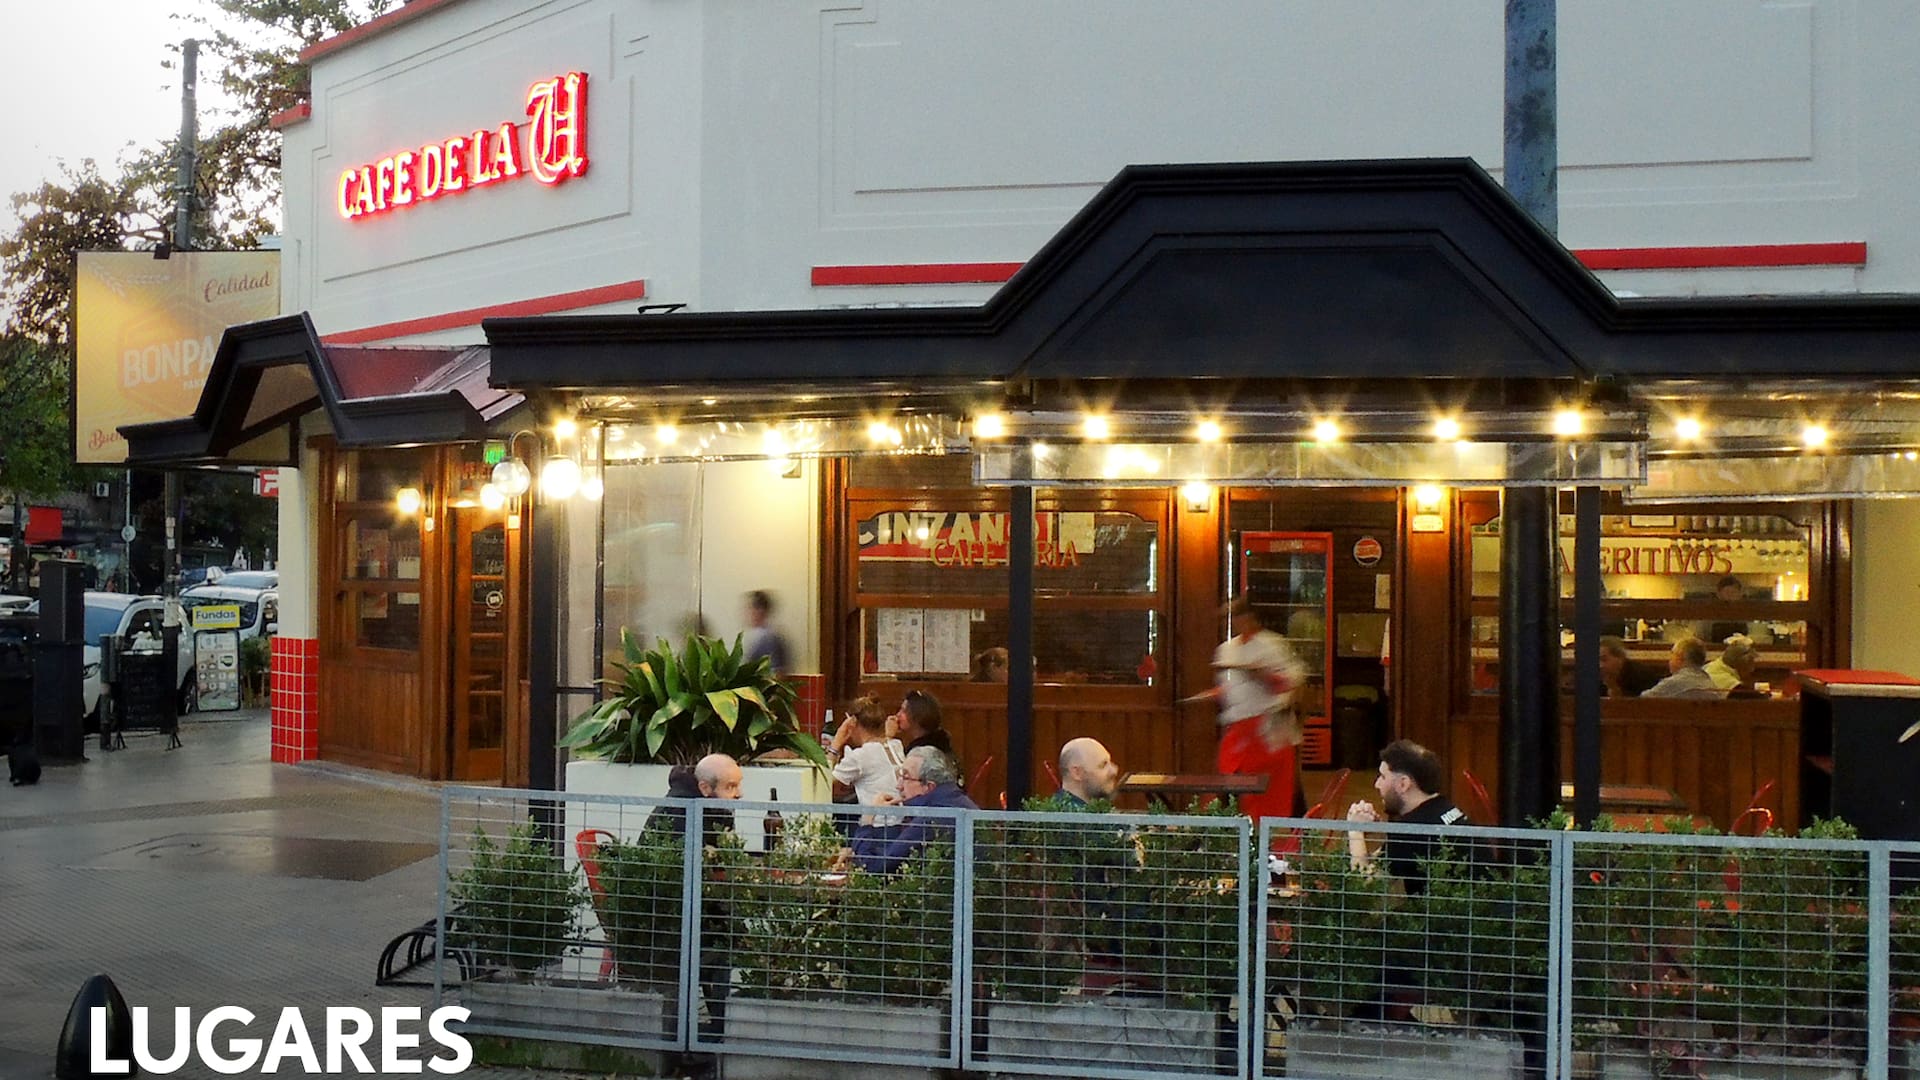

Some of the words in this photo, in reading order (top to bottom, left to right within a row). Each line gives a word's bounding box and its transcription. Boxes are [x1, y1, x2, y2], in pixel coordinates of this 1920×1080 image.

[337, 150, 415, 218] CAFE
[420, 136, 467, 197] DE
[472, 123, 520, 184] LA
[204, 270, 270, 303] Calidad
[124, 335, 221, 389] BONPA
[859, 512, 1040, 547] INZAN
[935, 540, 1080, 568] CAFERIA
[1558, 544, 1734, 575] AERITIVOS
[196, 610, 236, 619] Fundas
